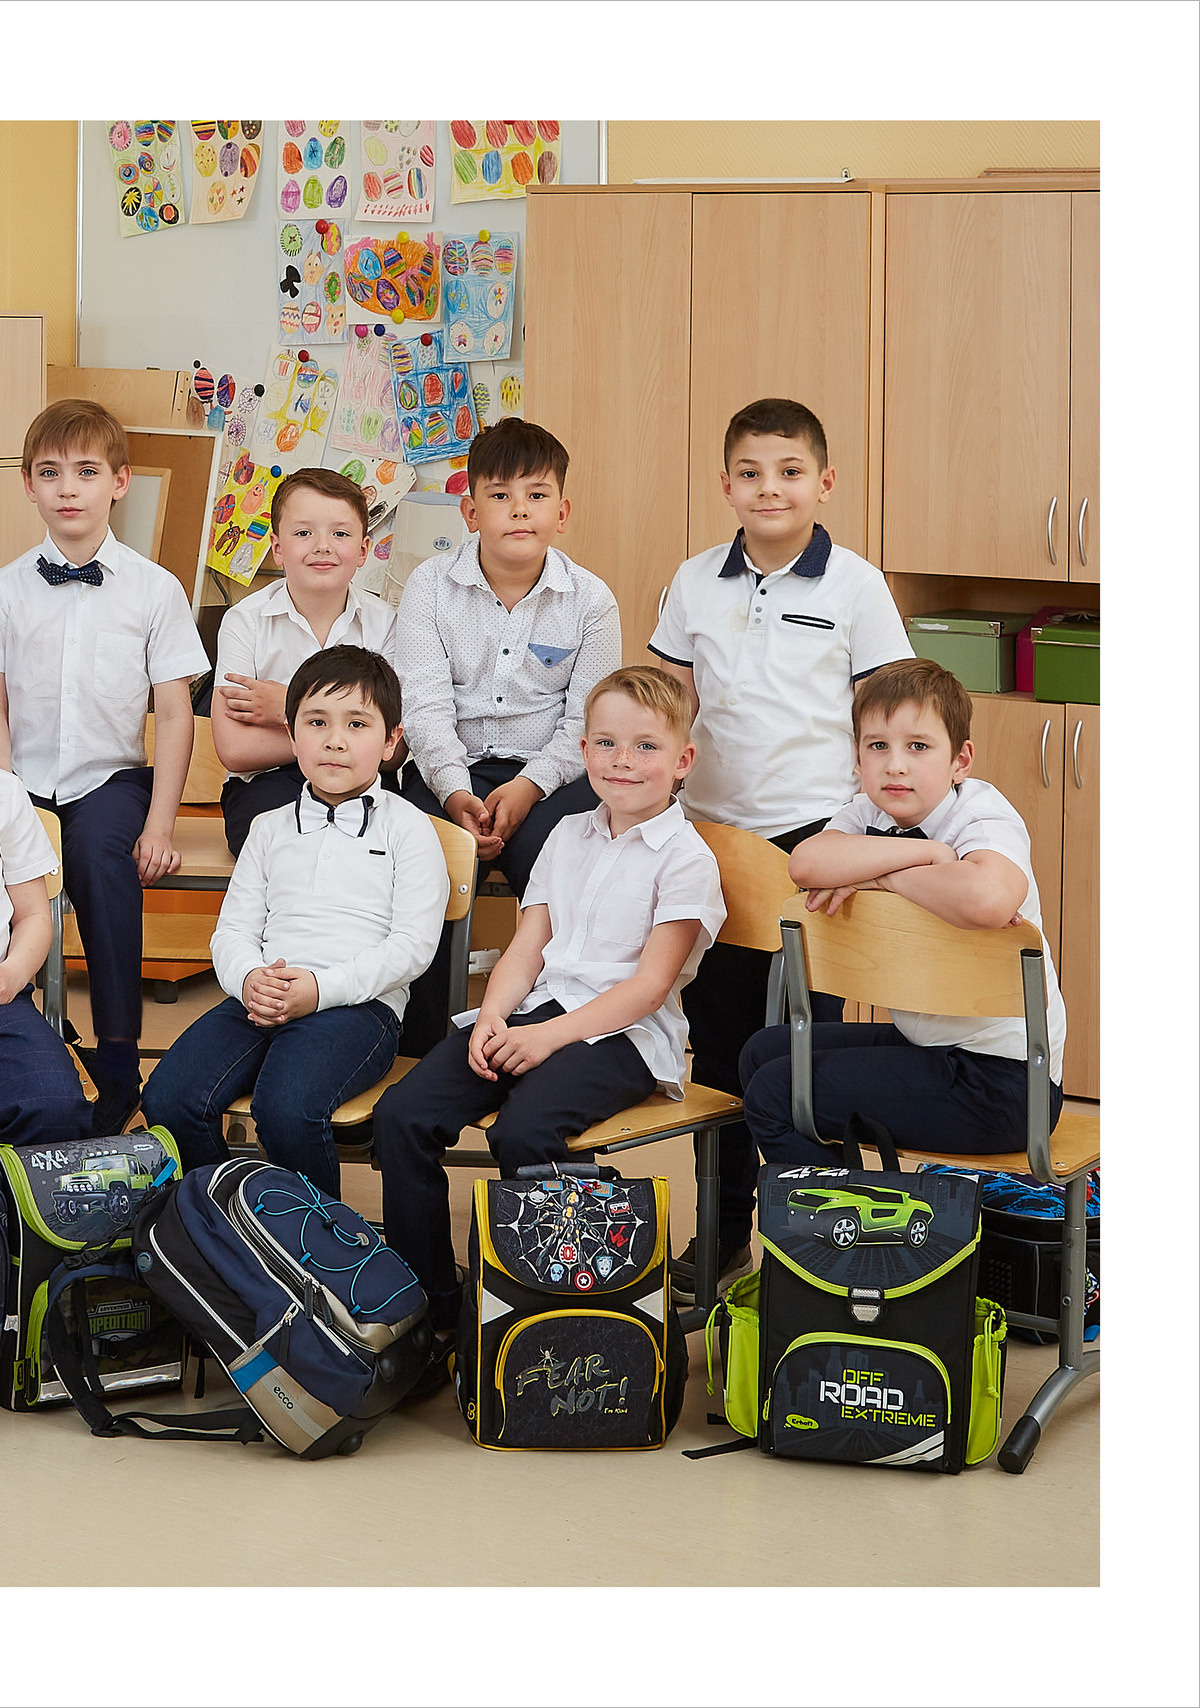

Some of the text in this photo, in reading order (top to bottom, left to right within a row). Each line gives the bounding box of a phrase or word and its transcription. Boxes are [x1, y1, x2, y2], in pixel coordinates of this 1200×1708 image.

[516, 1354, 610, 1397] FEAR
[842, 1369, 884, 1385] OFF
[273, 1386, 294, 1410] ecco
[550, 1376, 629, 1417] NOT!
[819, 1380, 904, 1411] ROAD
[841, 1405, 937, 1428] EXTREME
